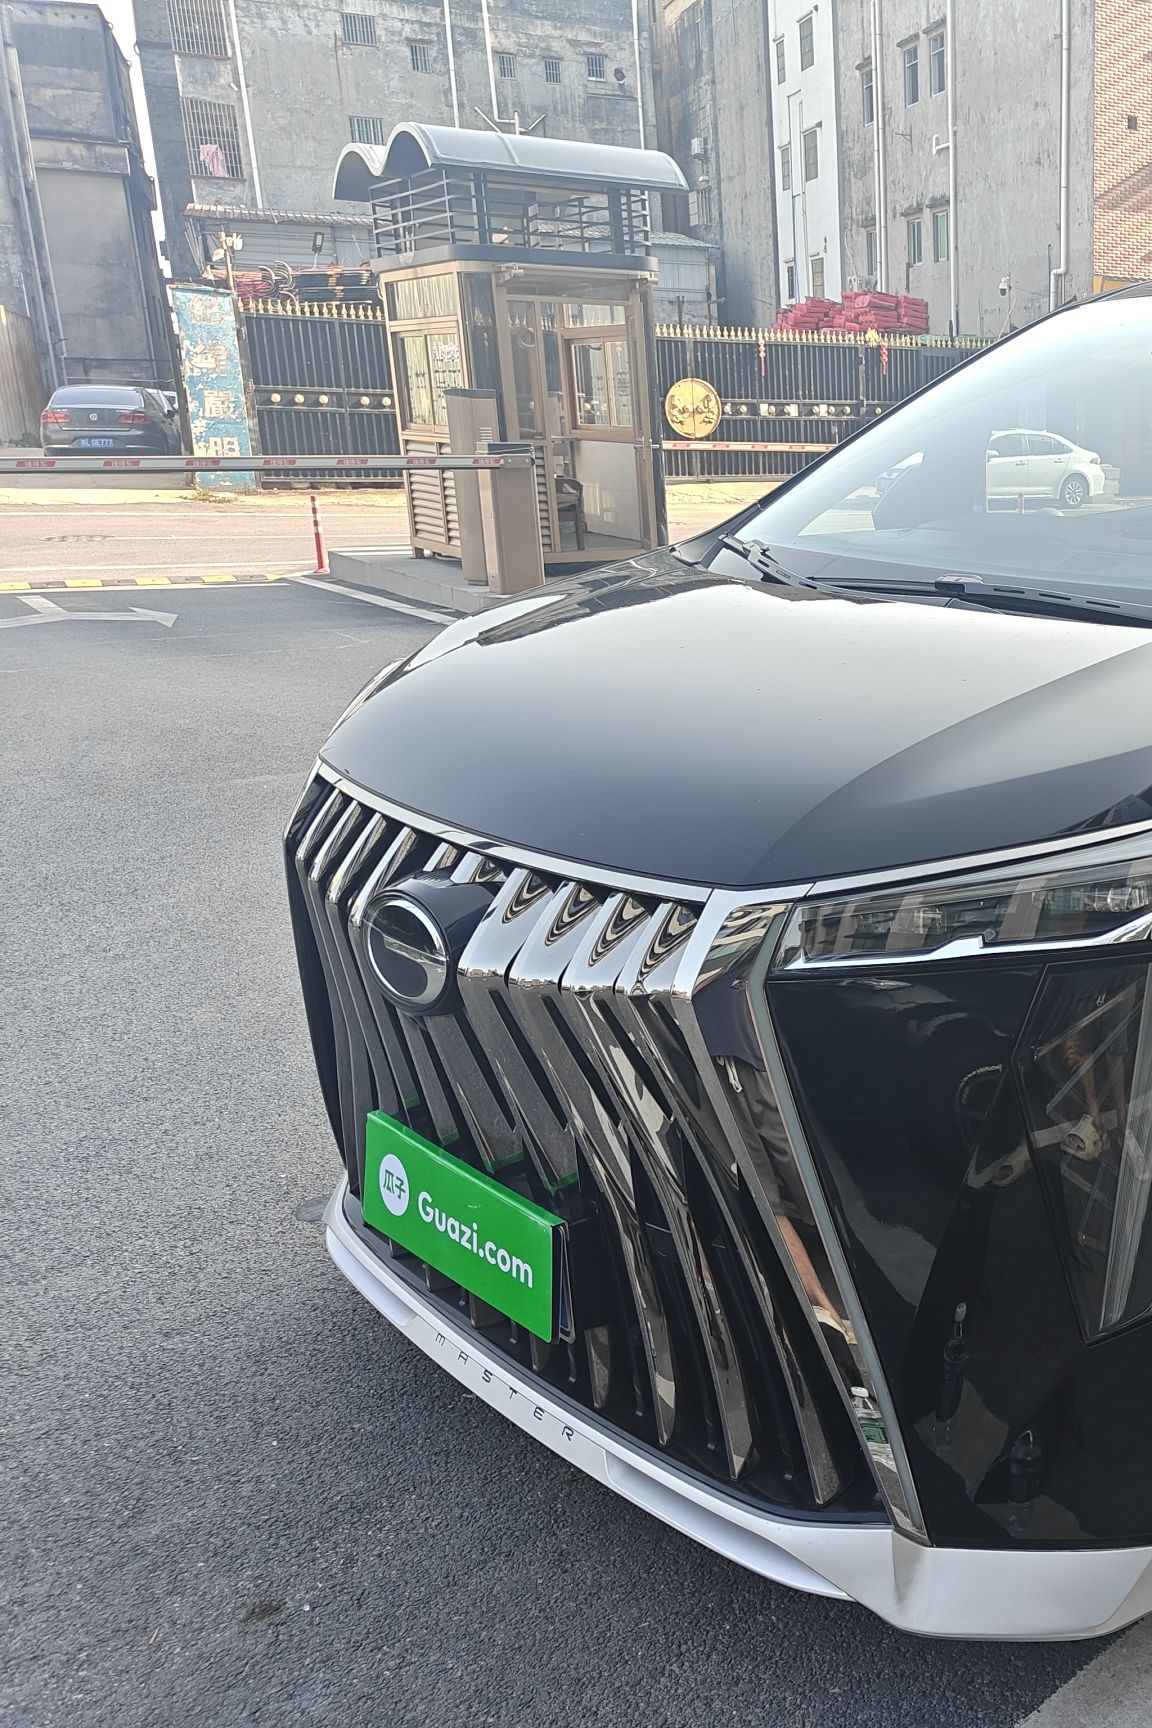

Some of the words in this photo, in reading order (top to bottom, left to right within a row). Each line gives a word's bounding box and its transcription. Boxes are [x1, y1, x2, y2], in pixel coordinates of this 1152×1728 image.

[382, 1169, 406, 1200] 瓜子
[418, 1191, 533, 1288] Guazi.com
[435, 1332, 575, 1442] MASTER
